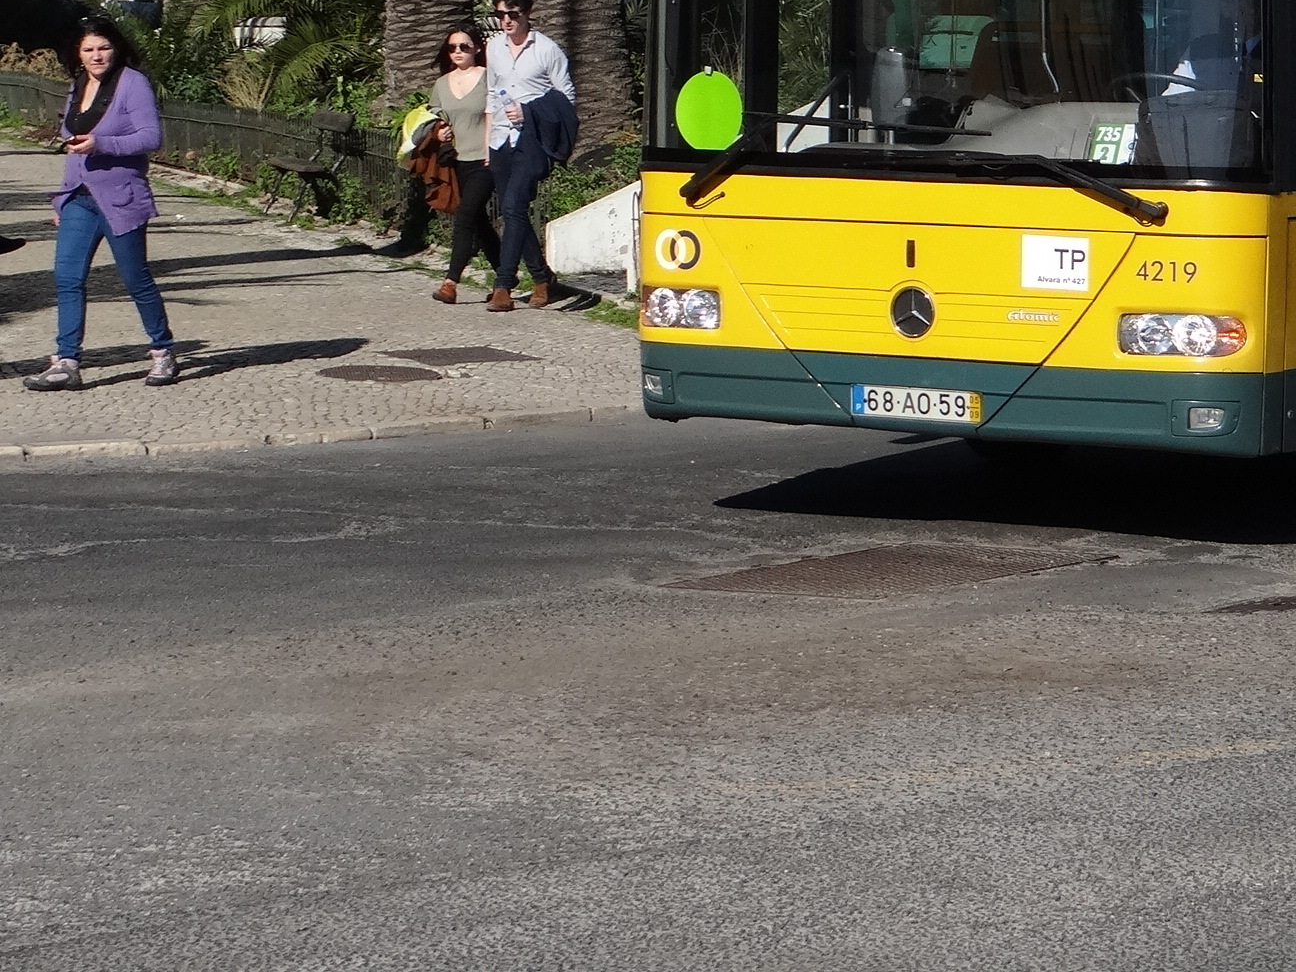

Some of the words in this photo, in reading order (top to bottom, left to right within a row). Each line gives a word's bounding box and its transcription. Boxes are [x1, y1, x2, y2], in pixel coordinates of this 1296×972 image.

[1095, 126, 1122, 142] 735
[1100, 146, 1110, 161] 2
[1054, 248, 1086, 270] TP
[1136, 260, 1197, 284] 4219
[1072, 277, 1086, 285] 427
[855, 403, 862, 411] P
[969, 395, 979, 404] 05
